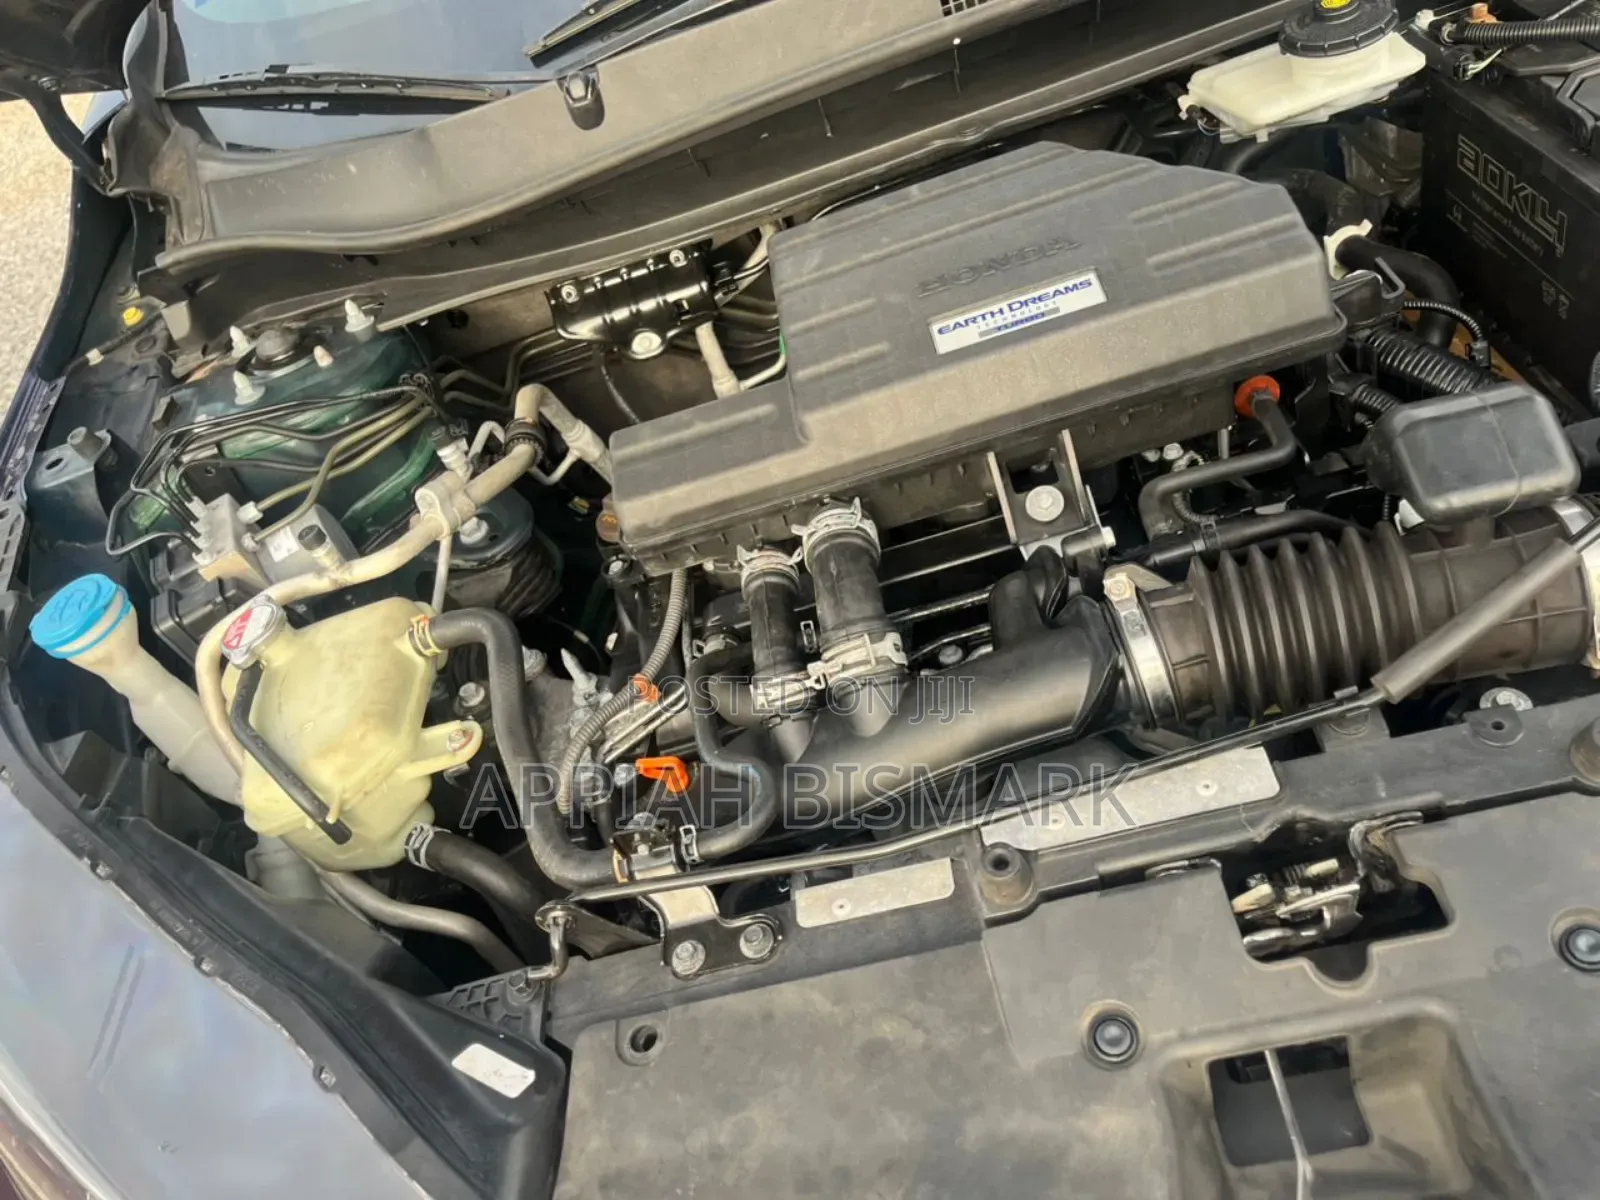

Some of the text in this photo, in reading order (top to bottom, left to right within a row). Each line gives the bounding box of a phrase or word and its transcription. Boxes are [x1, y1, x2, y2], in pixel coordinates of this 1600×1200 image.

[917, 237, 1082, 297] HONDA
[937, 278, 1093, 335] EARTH DREAMS
